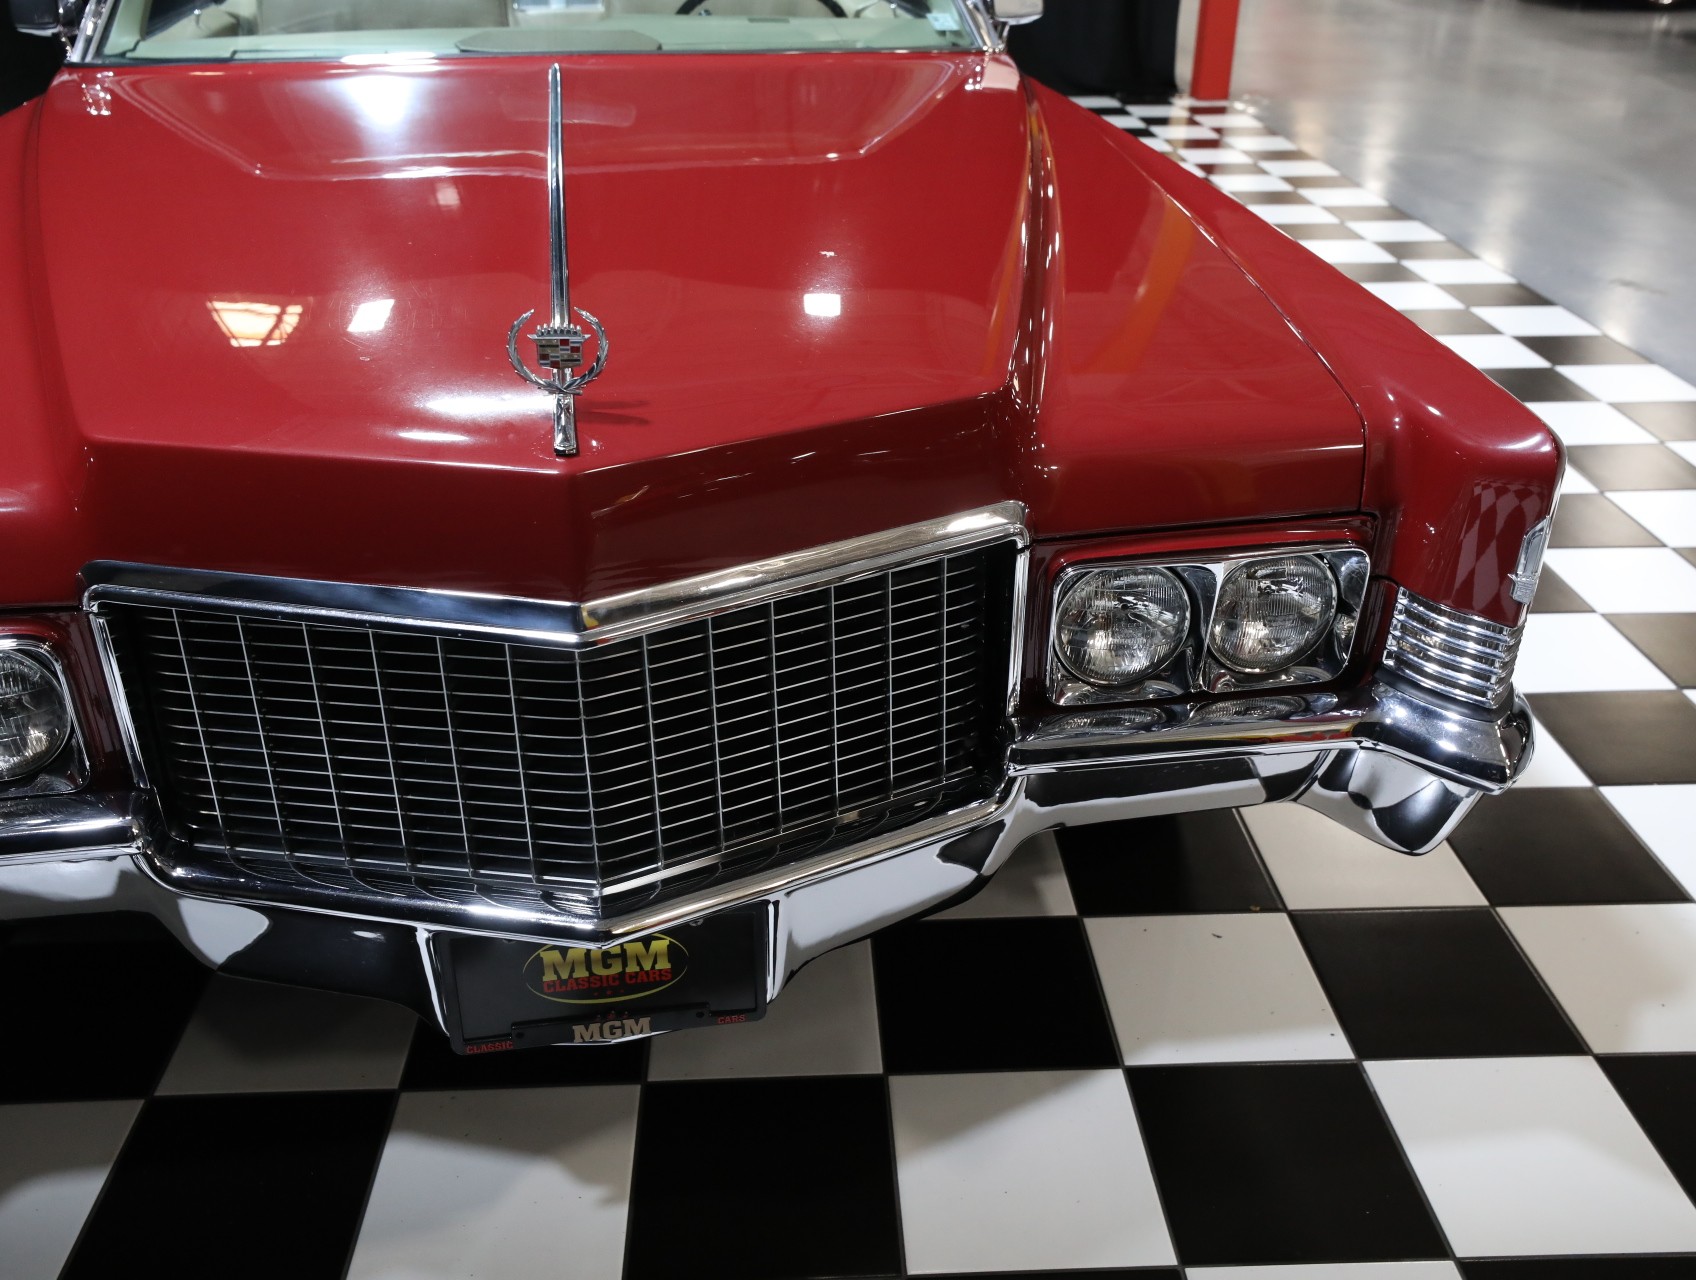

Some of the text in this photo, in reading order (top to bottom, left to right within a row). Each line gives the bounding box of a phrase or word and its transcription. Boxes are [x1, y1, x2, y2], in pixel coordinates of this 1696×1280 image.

[540, 940, 671, 981] MGM
[543, 968, 672, 993] CLASSIC CARS
[572, 1017, 651, 1043] MGM
[717, 1014, 746, 1024] CARS
[466, 1042, 513, 1054] CLASSIC
